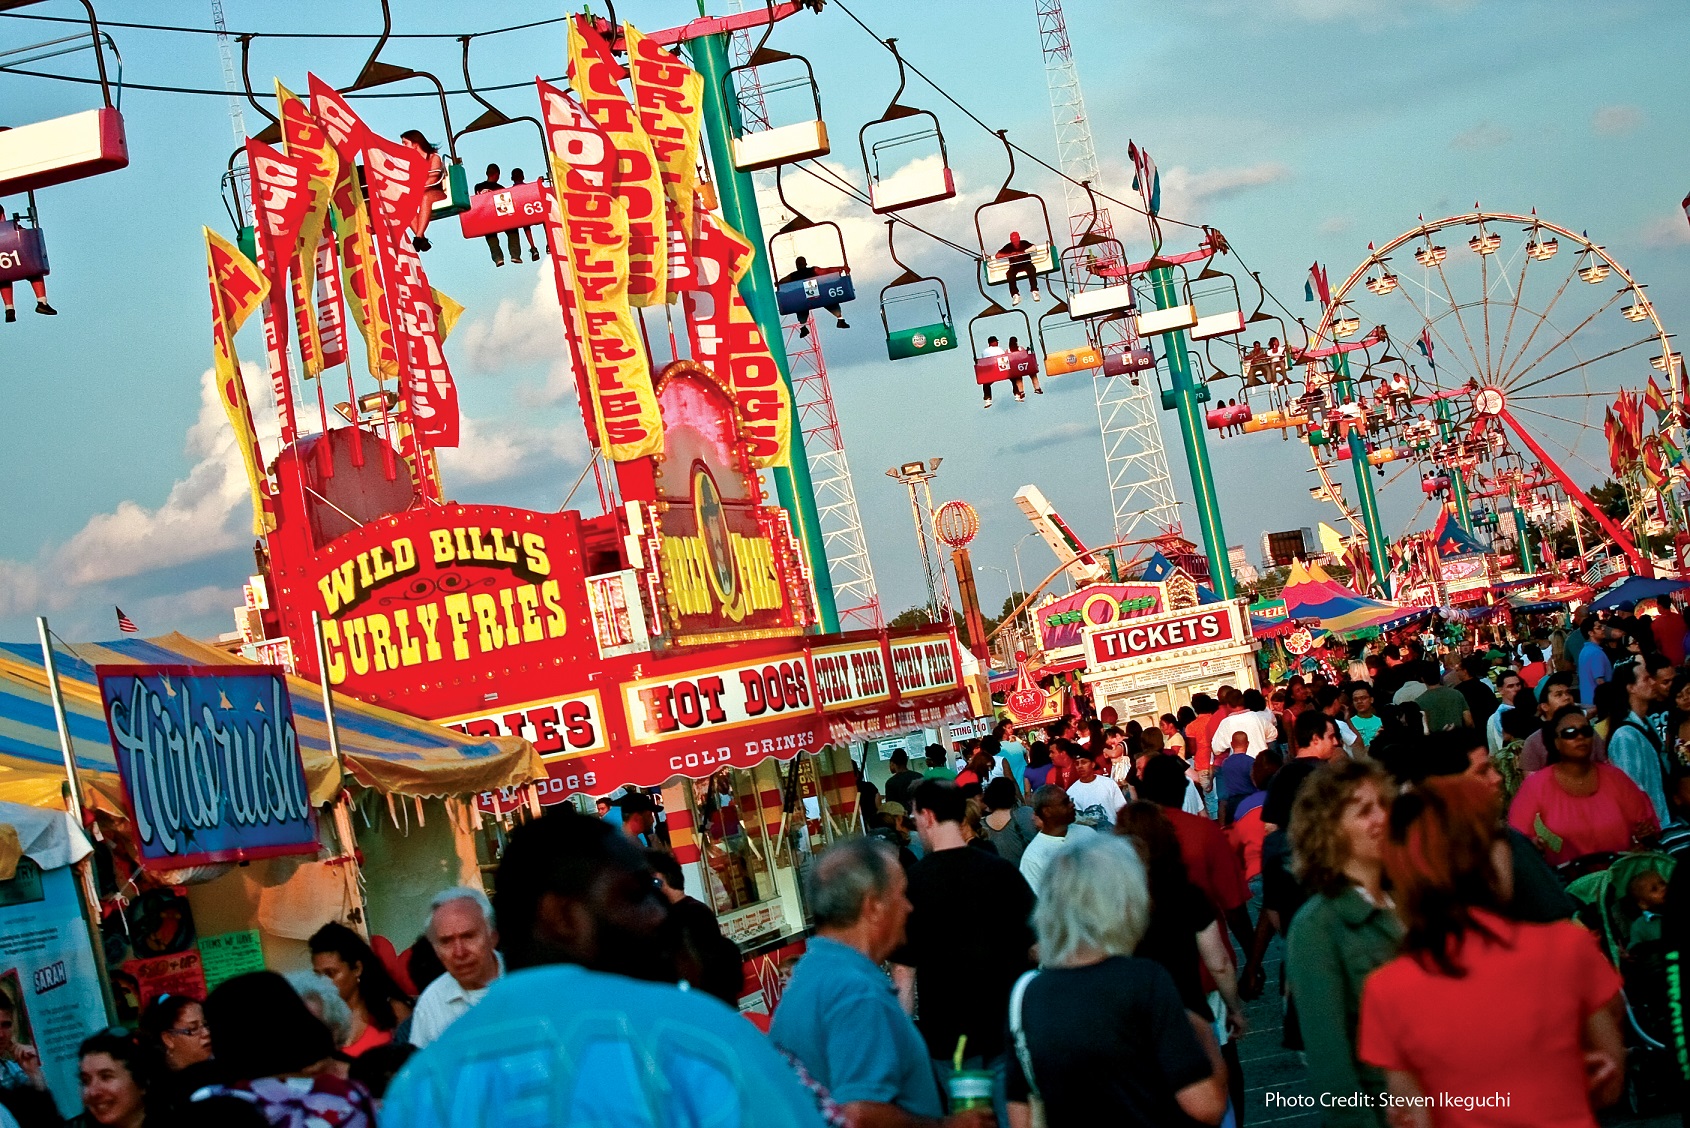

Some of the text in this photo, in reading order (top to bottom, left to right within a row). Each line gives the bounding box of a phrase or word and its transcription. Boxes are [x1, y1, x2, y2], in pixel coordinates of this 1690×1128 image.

[523, 200, 544, 216] 63
[563, 168, 622, 301] CURLY
[0, 249, 22, 270] 61
[827, 285, 845, 298] 65
[933, 336, 948, 348] 66
[1082, 354, 1095, 365] 68
[585, 311, 647, 445] FRIES
[1017, 361, 1029, 372] 67
[1137, 357, 1150, 367] 69
[1237, 411, 1248, 420] 71
[317, 537, 418, 615] WILD
[429, 526, 552, 577] BILL'S
[319, 602, 443, 685] CURLY
[445, 579, 568, 661] FRIES
[1101, 614, 1220, 656] TICKETS
[814, 649, 886, 705] CURLY FRIES
[892, 642, 955, 691] CURLY FRIES
[638, 659, 811, 734] HOT DOGS
[447, 701, 596, 753] IES
[950, 725, 972, 737] ETTING
[110, 674, 309, 855] Airbrush
[669, 731, 814, 770] COLD DRINKS
[34, 960, 68, 994] SARAH
